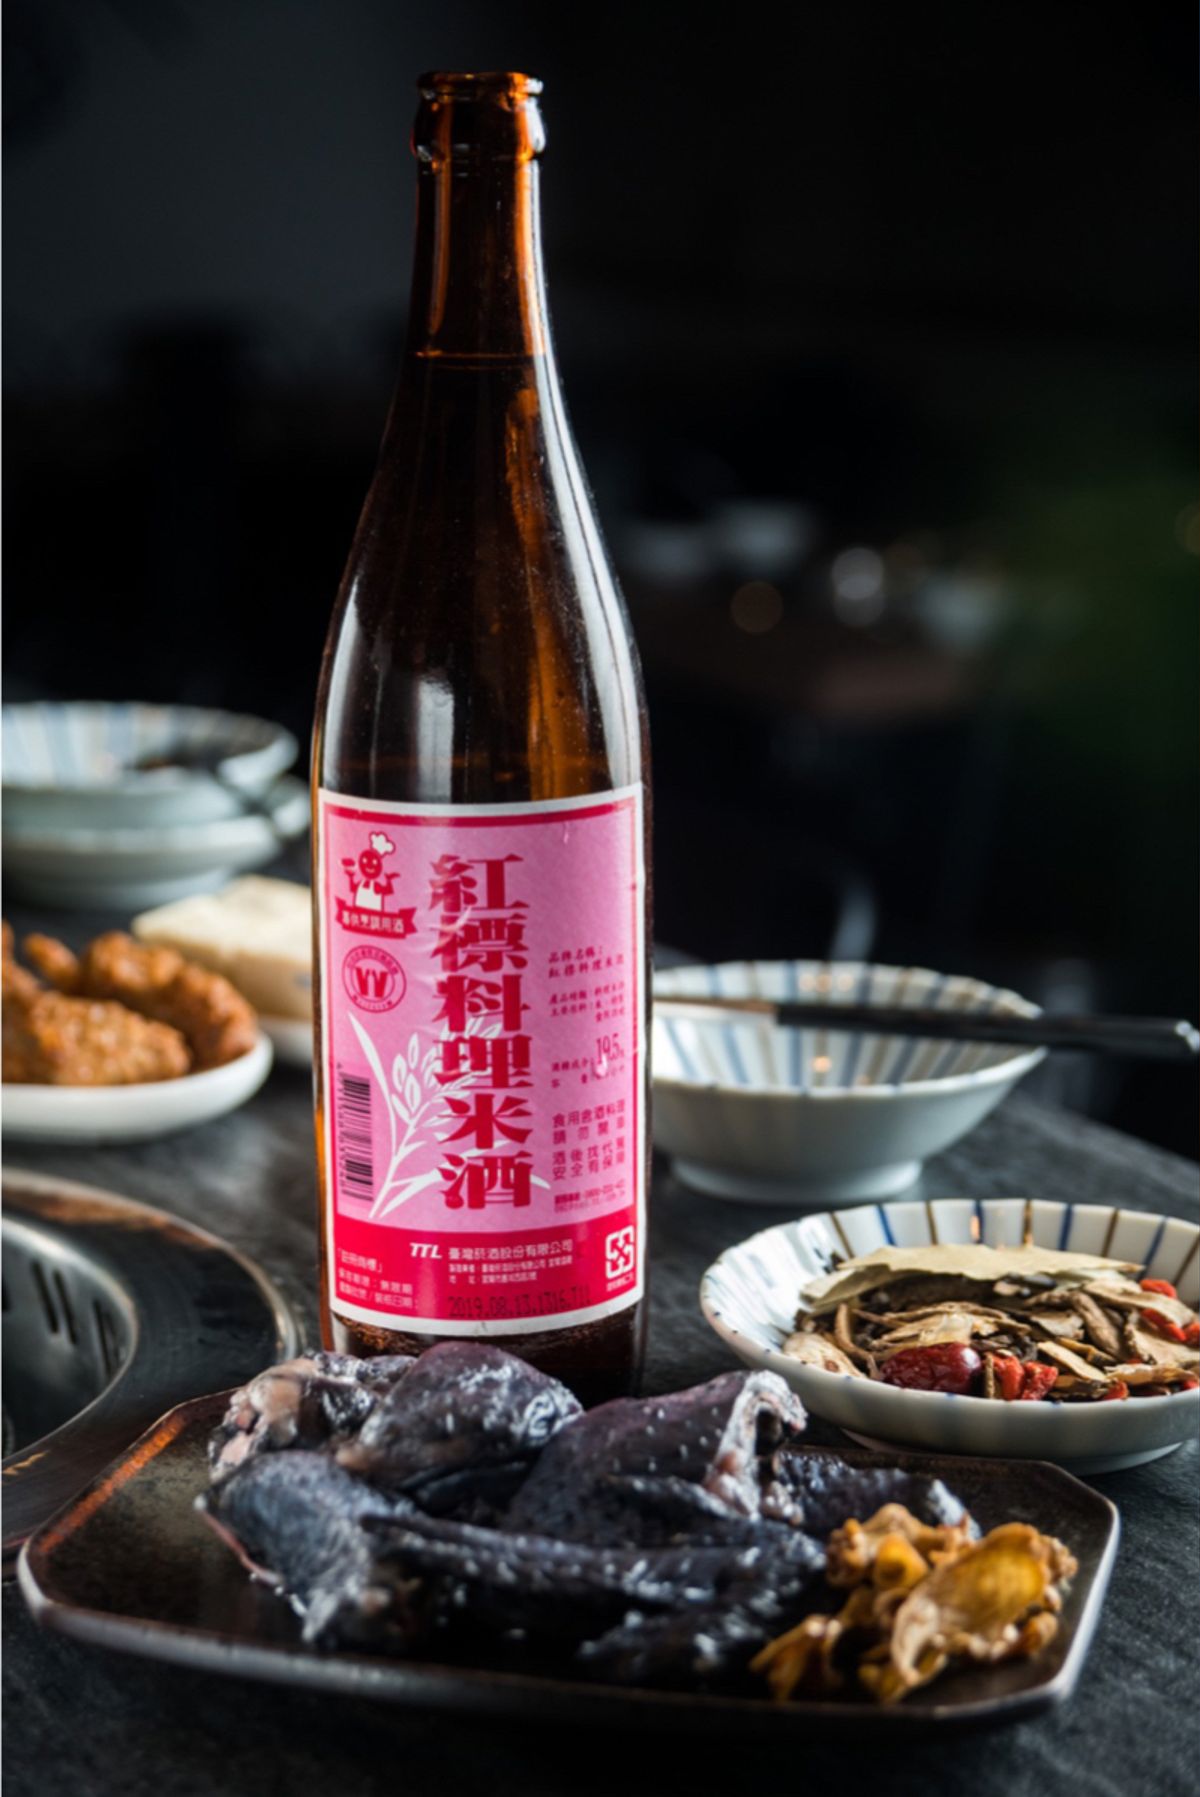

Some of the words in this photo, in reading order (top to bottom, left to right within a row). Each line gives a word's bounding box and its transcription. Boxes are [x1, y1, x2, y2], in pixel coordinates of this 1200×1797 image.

[428, 853, 534, 1210] 紅標料理米酒
[410, 1242, 442, 1260] TTL
[449, 1239, 573, 1260] 臺灣菸酒股份有限公司
